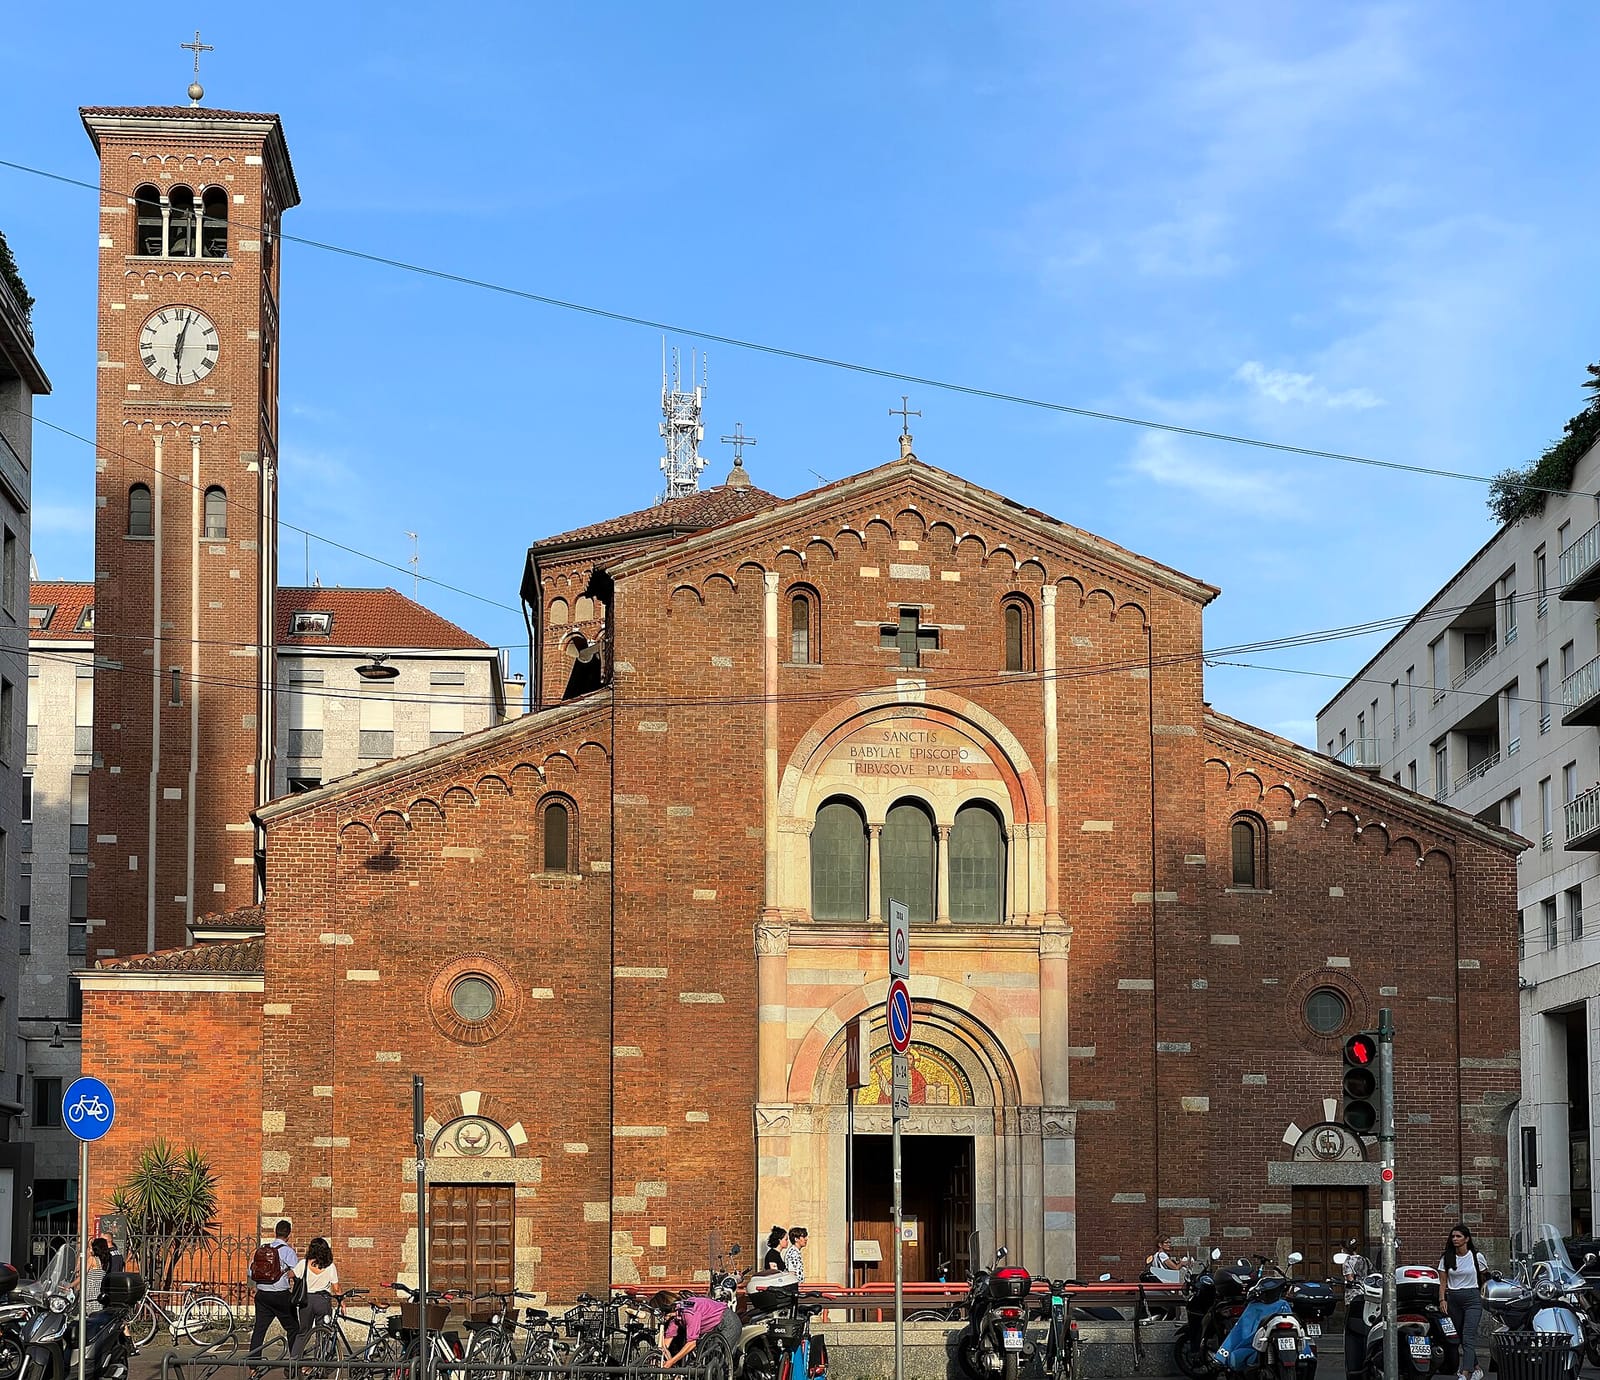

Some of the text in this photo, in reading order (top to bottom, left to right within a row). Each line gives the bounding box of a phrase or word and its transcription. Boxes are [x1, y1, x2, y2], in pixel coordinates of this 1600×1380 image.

[883, 731, 937, 743] SANCTIS
[850, 746, 969, 760] BABYLAE EPISCOPO
[847, 762, 915, 776] TRIBVSQVE
[848, 1036, 859, 1074] M
